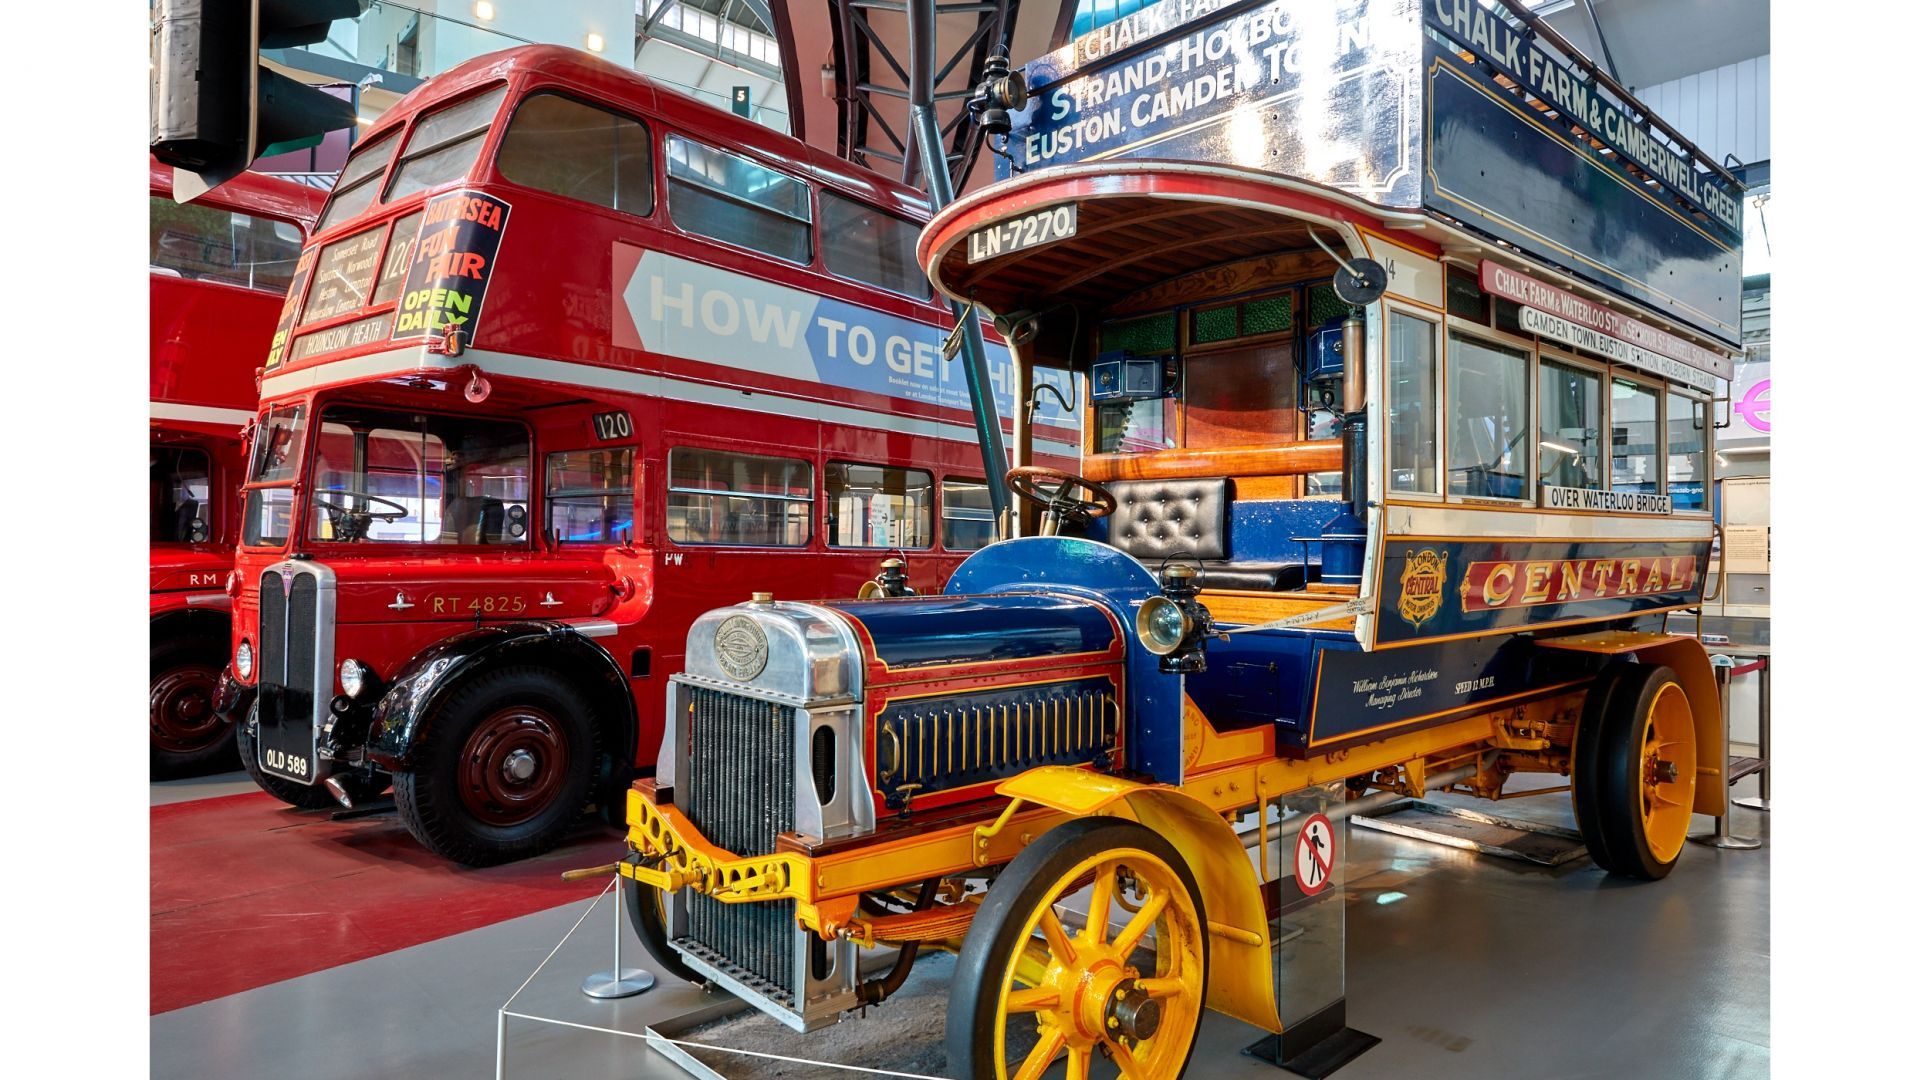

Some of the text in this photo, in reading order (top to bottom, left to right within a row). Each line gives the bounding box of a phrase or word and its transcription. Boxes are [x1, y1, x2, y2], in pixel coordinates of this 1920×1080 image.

[736, 90, 746, 101] 5
[1529, 47, 1588, 123] FARM
[1590, 98, 1602, 132] &
[1605, 107, 1702, 204] CAMBERWELL
[1703, 181, 1740, 231] GREEN
[417, 224, 461, 264] FUN
[424, 252, 486, 284] FAIR
[404, 288, 473, 315] OPEN
[650, 275, 801, 349] HOW
[1495, 268, 1528, 300] CHALK
[1530, 281, 1555, 309] FARM
[1560, 293, 1604, 329] WATERLOO
[397, 308, 469, 332] DAILY
[305, 320, 382, 355] HOUNSLOW HEATH
[817, 315, 876, 366] TO
[884, 334, 955, 383] GET
[1526, 310, 1568, 339] CAMDEN
[1600, 336, 1628, 361] EUSTON
[1631, 347, 1659, 372] STATION
[599, 413, 628, 439] 120
[1552, 488, 1580, 508] OVER
[1583, 490, 1634, 511] WATERLOO
[1413, 552, 1439, 571] LONDON
[1405, 575, 1440, 595] CENTRAL
[1482, 557, 1687, 607] CENTRAL
[433, 596, 523, 613] RT 4825
[1397, 686, 1422, 701] Director
[1454, 680, 1472, 695] SPEED
[266, 749, 307, 776] OLD 589
